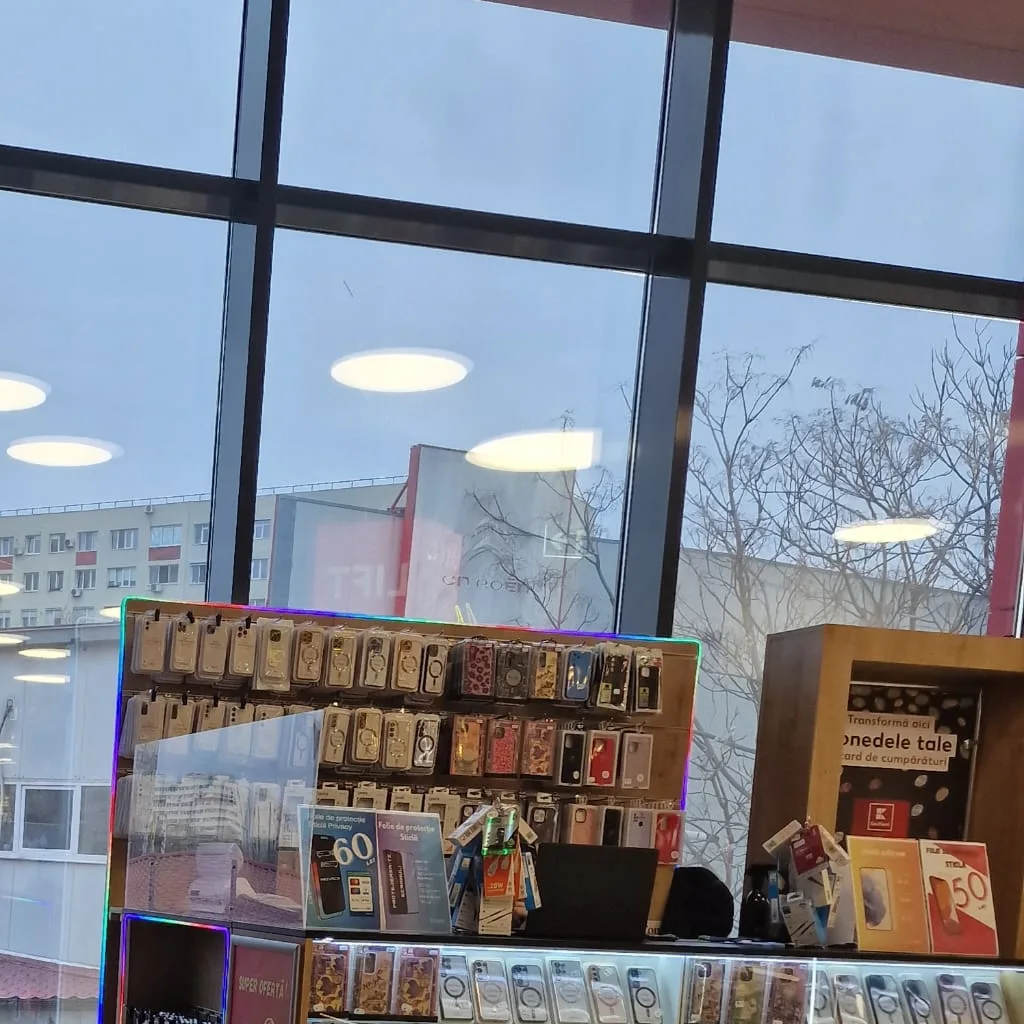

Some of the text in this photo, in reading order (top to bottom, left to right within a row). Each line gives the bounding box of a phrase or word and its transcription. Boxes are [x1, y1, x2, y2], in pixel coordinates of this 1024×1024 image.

[848, 714, 931, 729] Transformă aici
[917, 736, 953, 753] tale
[842, 752, 947, 766] ard de cumpărături
[328, 822, 353, 832] Privacy
[378, 820, 395, 830] Folie
[395, 822, 405, 830] de
[333, 832, 373, 866] 60
[952, 871, 987, 907] 50
[239, 976, 258, 993] SUPER
